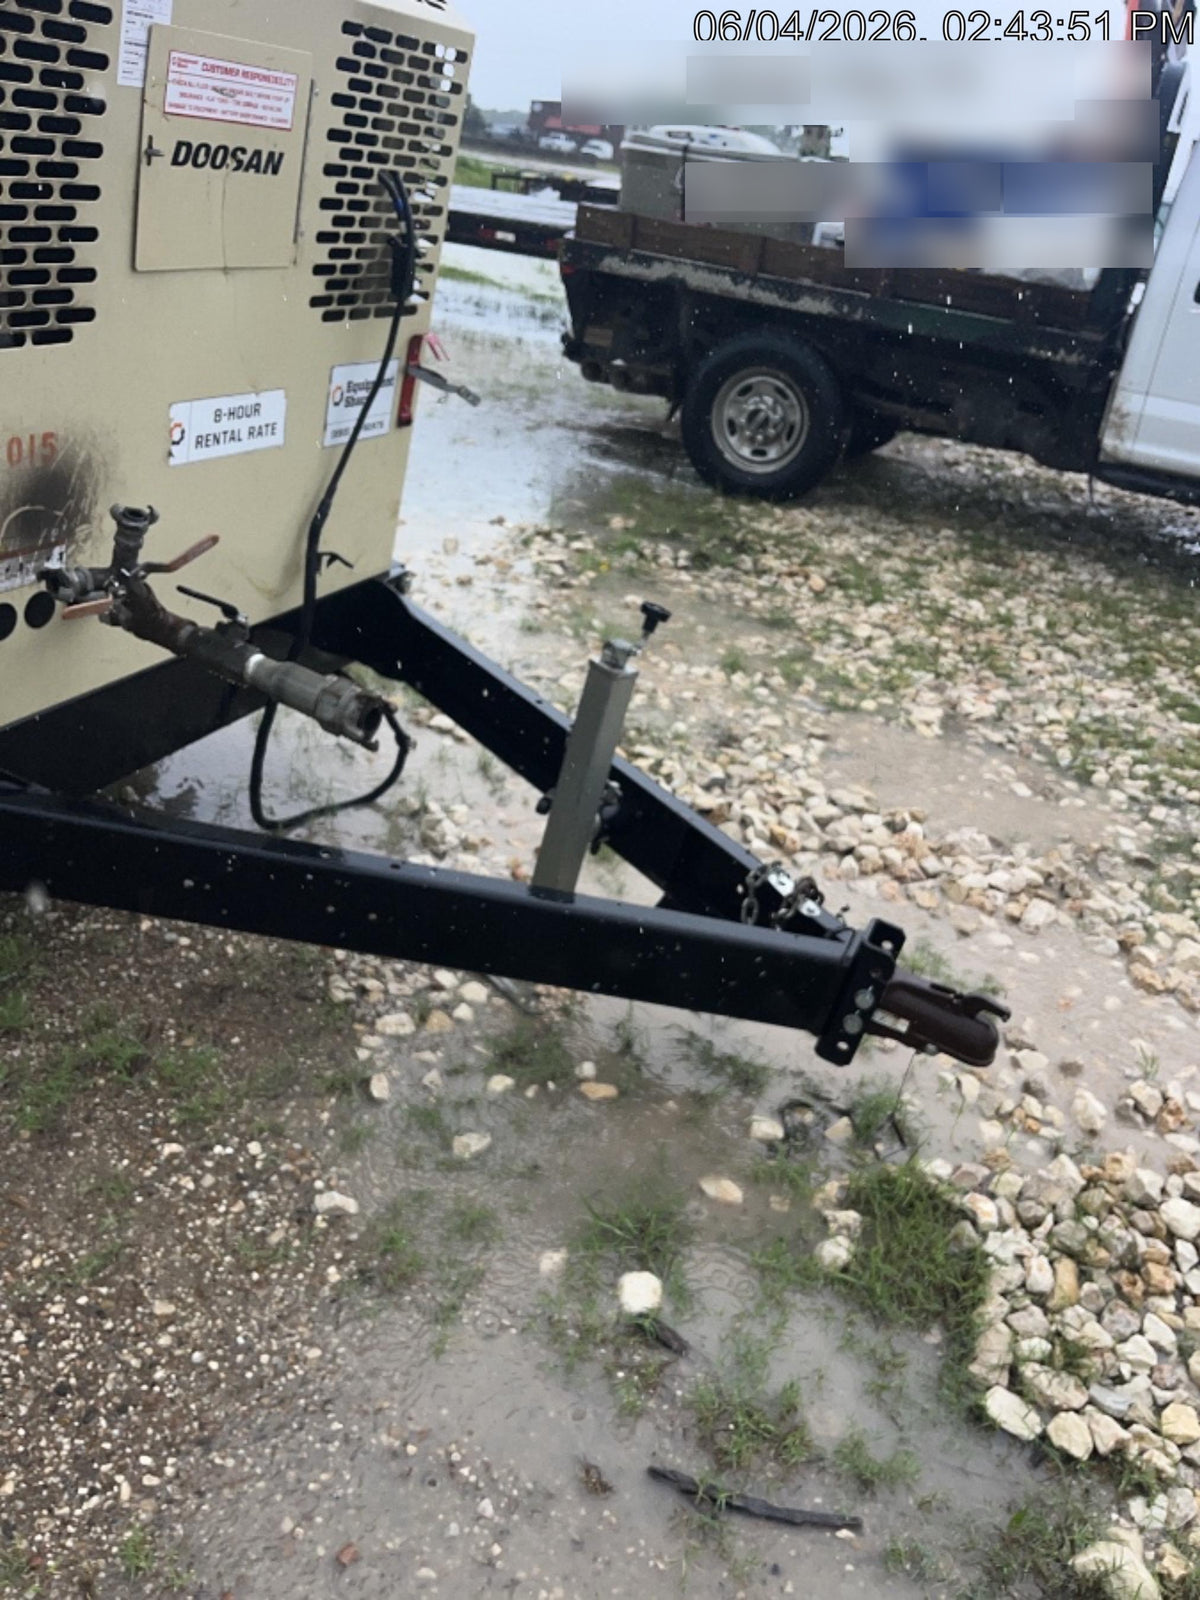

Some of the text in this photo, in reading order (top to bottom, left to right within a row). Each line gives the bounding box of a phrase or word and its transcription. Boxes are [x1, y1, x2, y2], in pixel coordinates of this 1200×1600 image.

[170, 140, 285, 175] DOOSAN
[213, 403, 262, 423] 8-HOUR
[195, 422, 278, 449] RENTAL RATE
